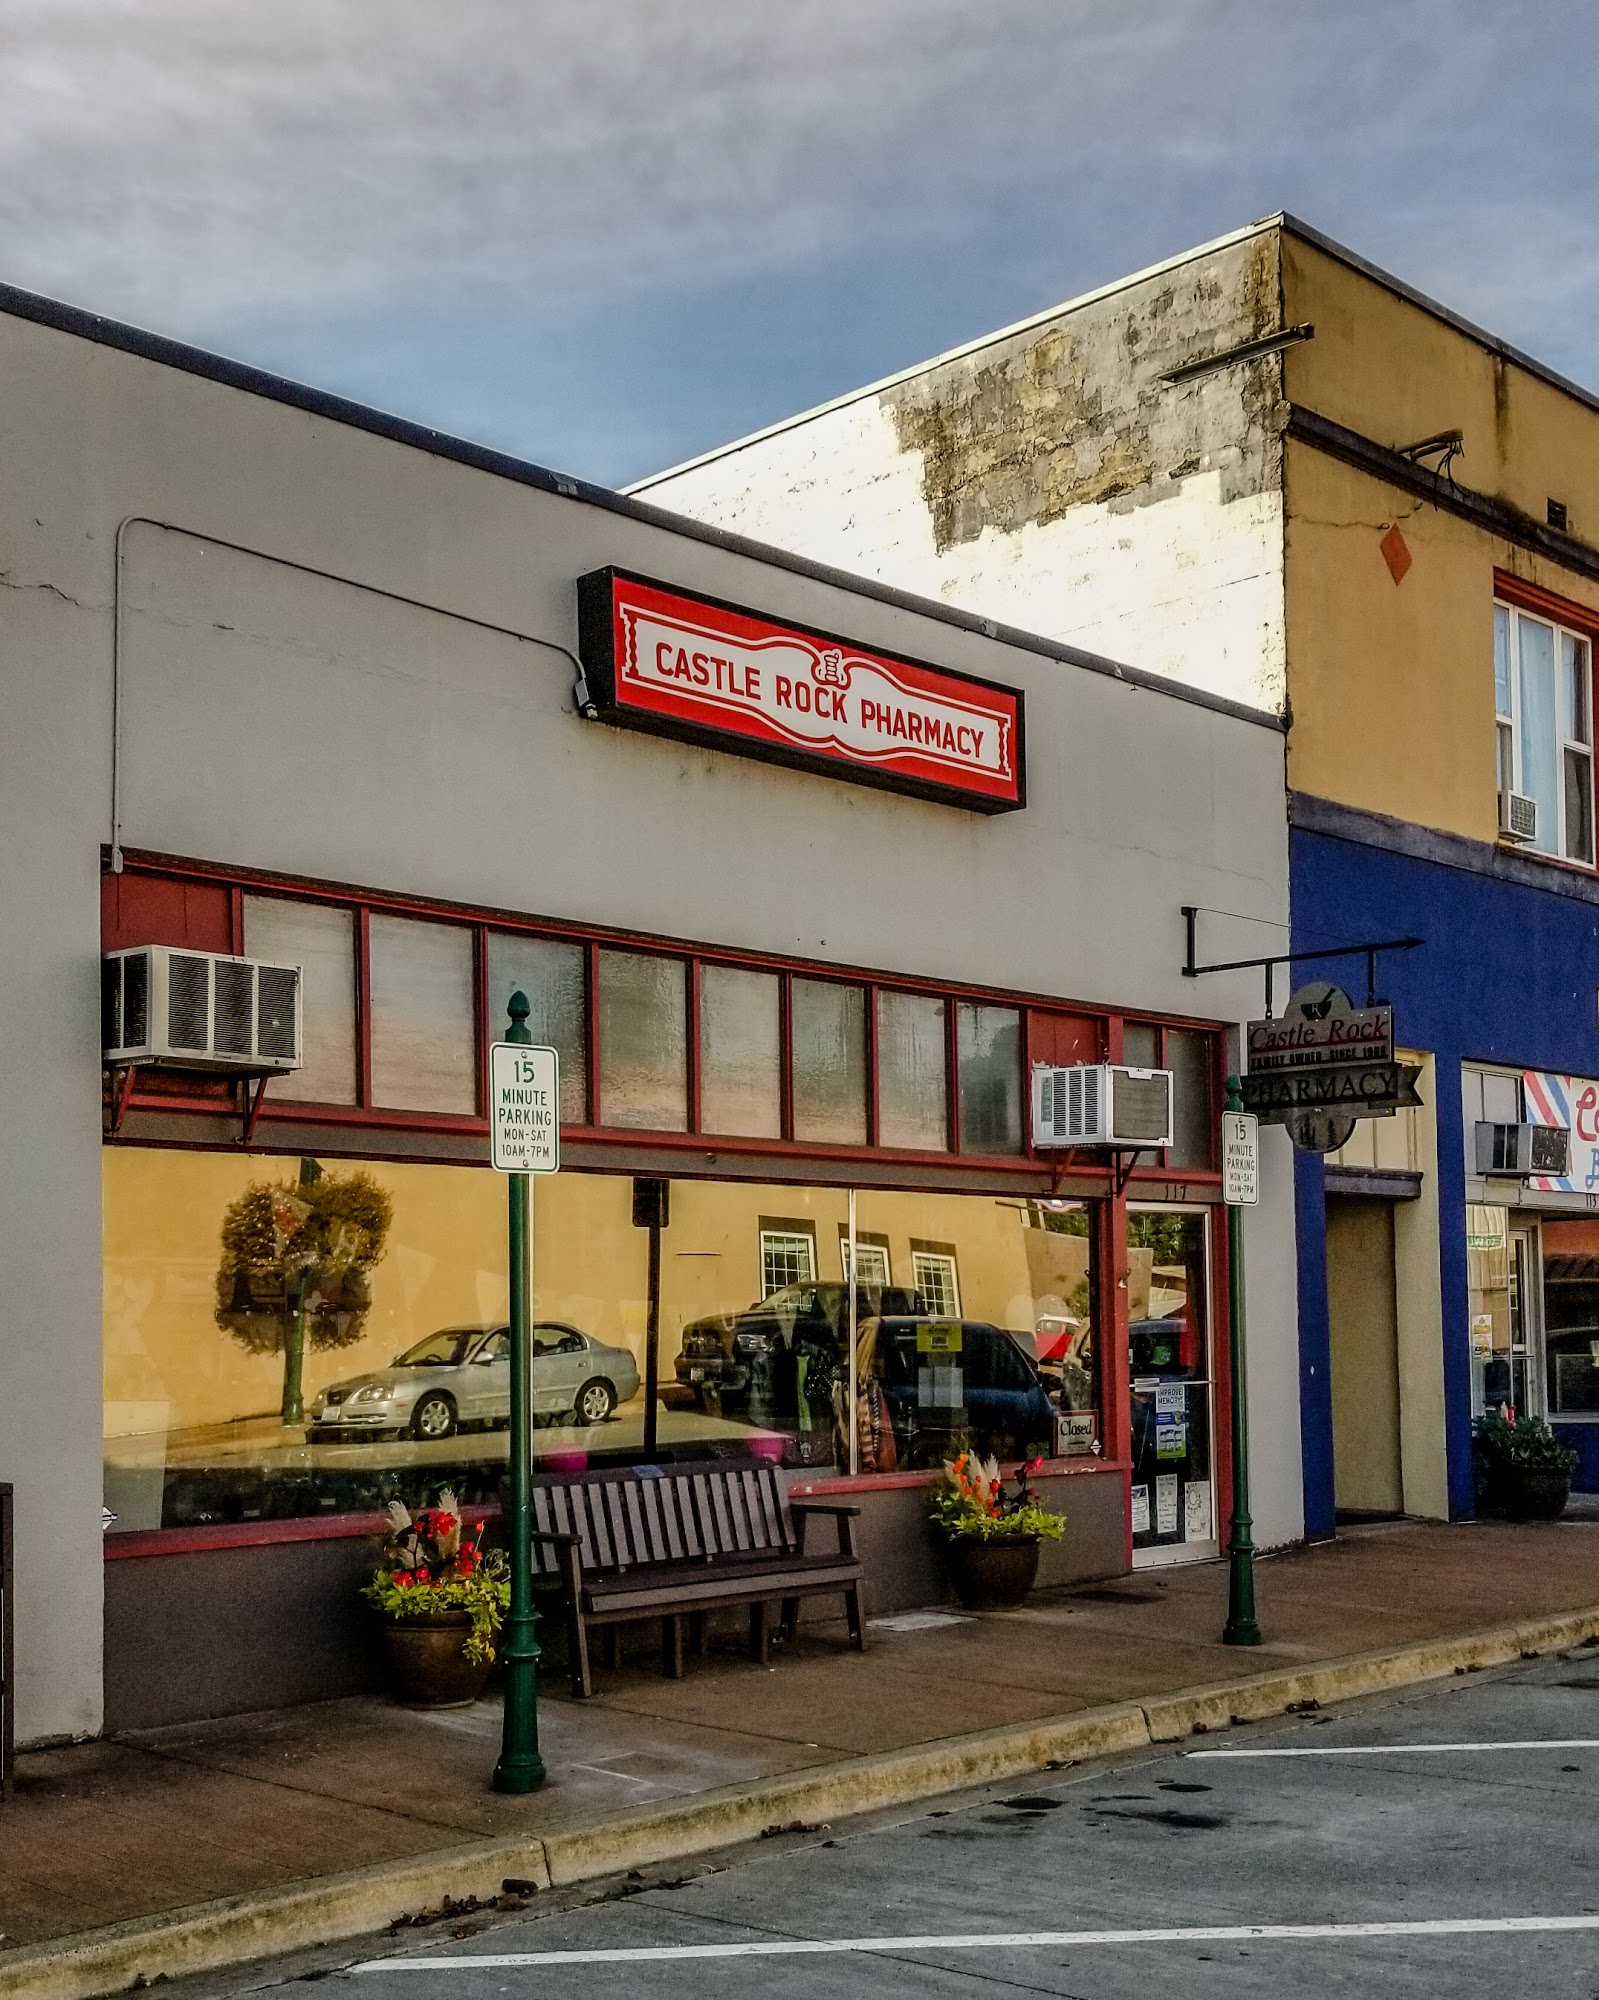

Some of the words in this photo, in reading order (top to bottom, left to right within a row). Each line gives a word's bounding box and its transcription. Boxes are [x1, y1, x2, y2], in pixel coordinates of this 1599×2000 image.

[656, 642, 762, 700] CASTLE
[776, 674, 848, 723] ROCK
[860, 699, 985, 758] PHARMACY
[1249, 1023, 1315, 1050] Castle
[1329, 1014, 1389, 1042] Rock
[1330, 1047, 1357, 1060] SINCE
[514, 1060, 535, 1084] 15
[1245, 1071, 1395, 1104] PHARMACY
[502, 1087, 548, 1106] MINUTE
[498, 1108, 552, 1126] PARKING
[504, 1128, 547, 1141] MON-SAT
[1234, 1124, 1246, 1140] 15
[502, 1144, 550, 1158] 10AM-7PM
[1228, 1143, 1253, 1157] MINUTE
[1227, 1158, 1255, 1171] PARKING
[1229, 1172, 1253, 1182] MON-SAT
[1165, 1184, 1186, 1200] 117
[1228, 1183, 1254, 1194] 10AM-7PM
[1586, 1193, 1597, 1208] 113
[1158, 1388, 1182, 1397] IMPROVE
[1060, 1419, 1092, 1436] Closed
